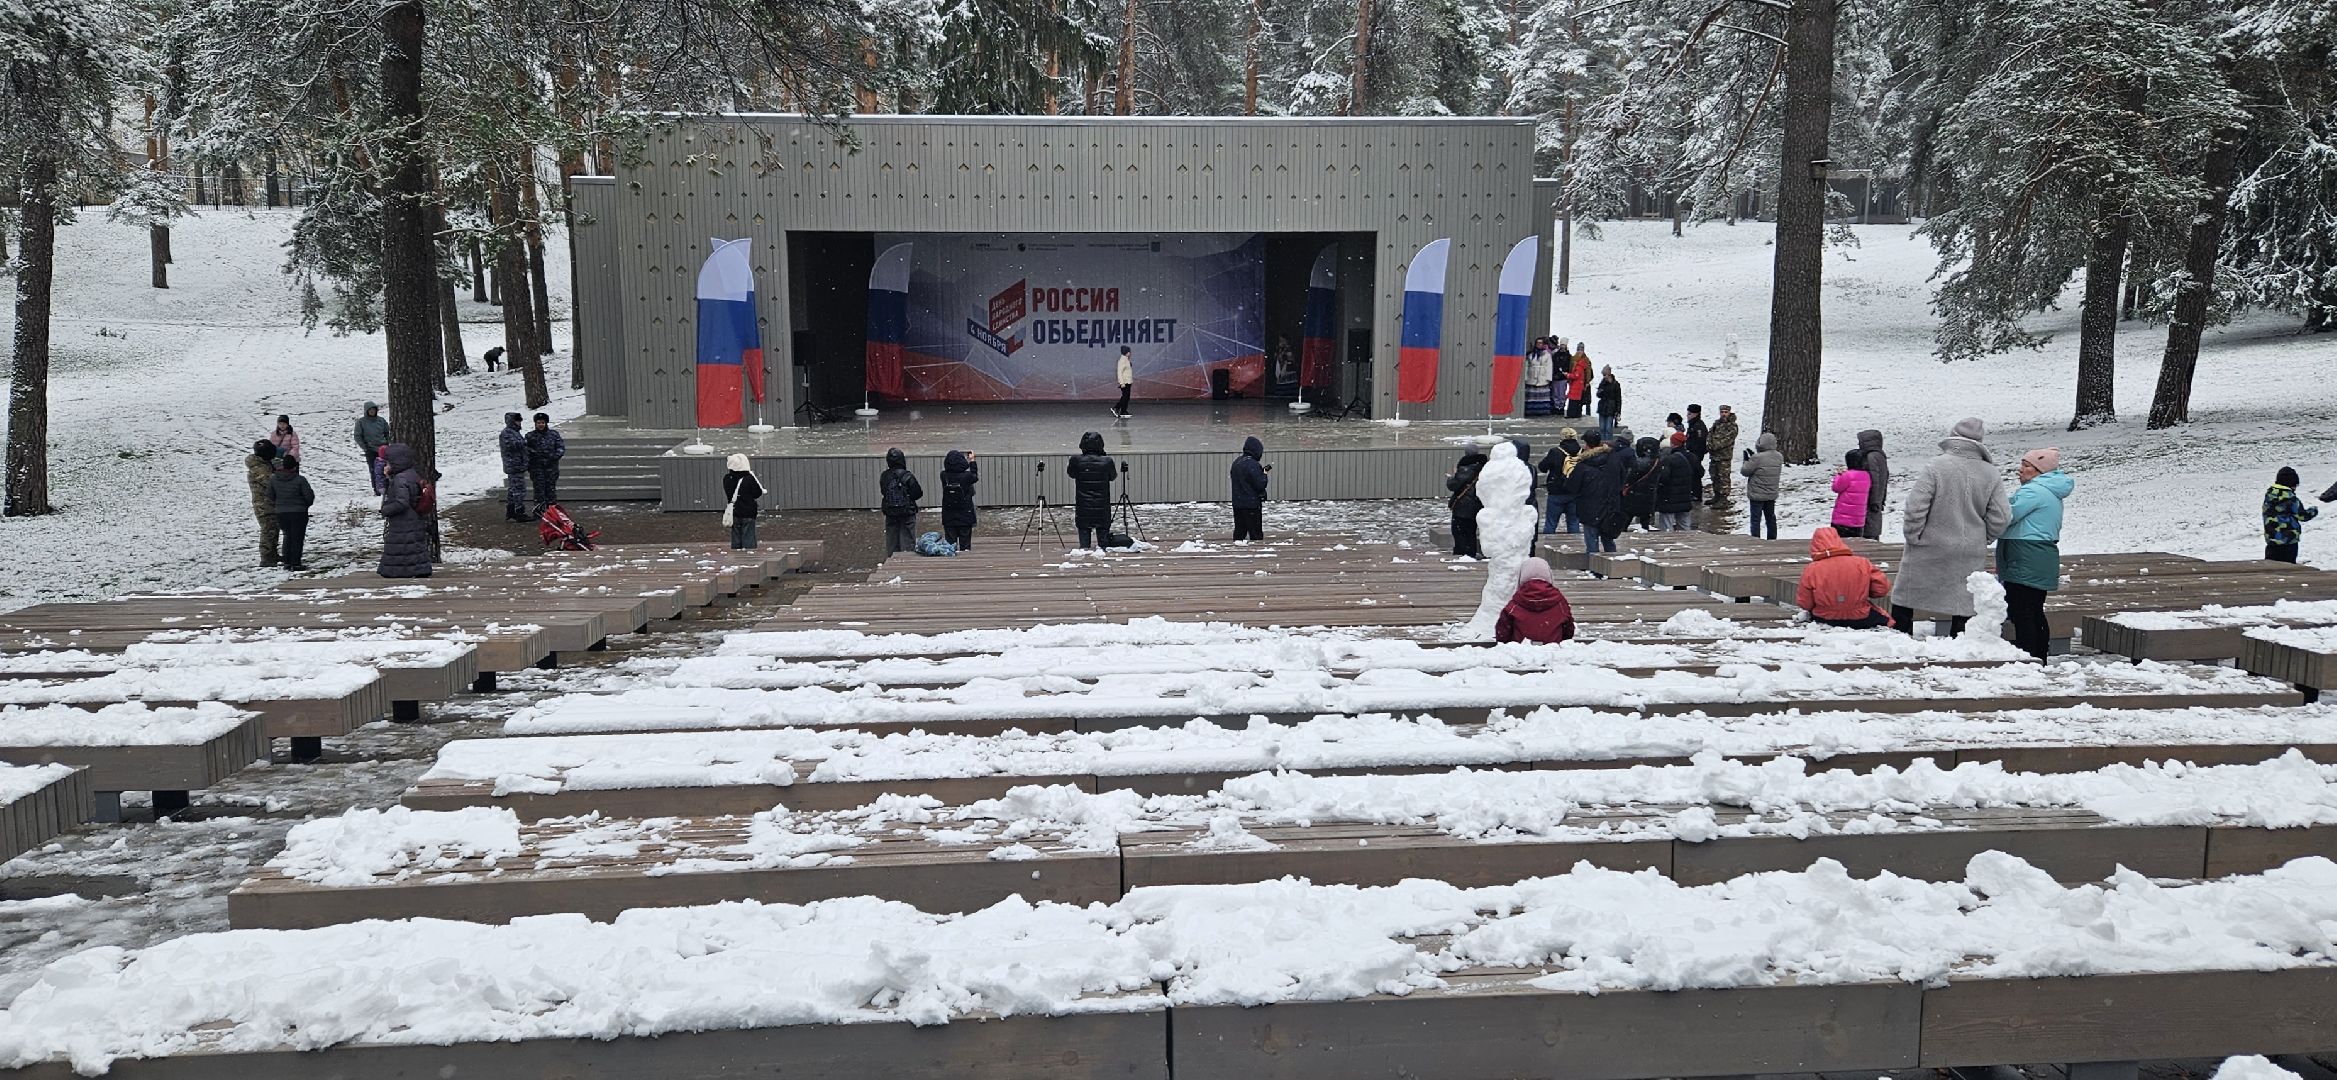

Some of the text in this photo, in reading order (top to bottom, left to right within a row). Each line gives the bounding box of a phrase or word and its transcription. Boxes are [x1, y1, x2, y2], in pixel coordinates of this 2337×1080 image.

[1032, 287, 1119, 313] РОССИЯ
[970, 324, 1006, 353] 4 НОЯБРЯ
